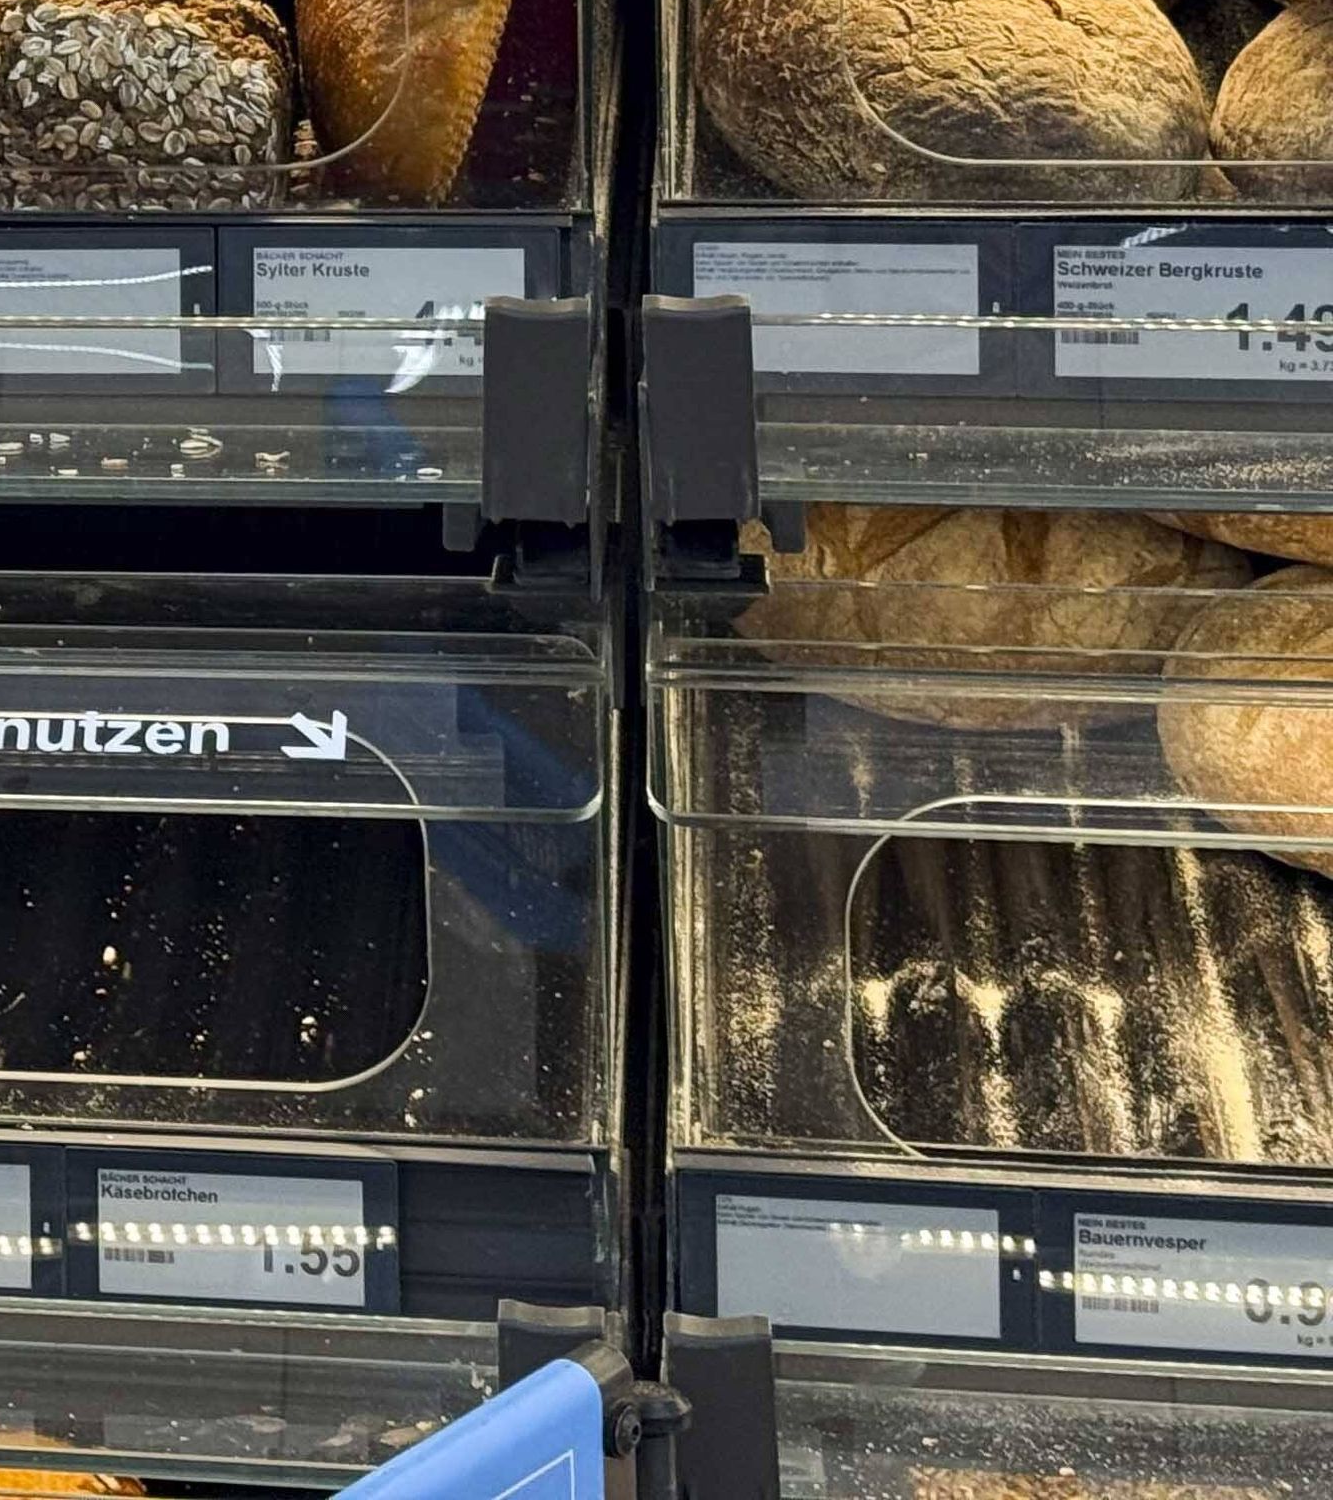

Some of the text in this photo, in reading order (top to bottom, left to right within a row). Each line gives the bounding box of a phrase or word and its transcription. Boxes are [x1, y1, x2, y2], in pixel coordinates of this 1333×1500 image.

[256, 263, 370, 278] Sylter Kruste
[1057, 261, 1263, 281] Schweizer Bergkruste
[1226, 303, 1333, 352] 1.49
[459, 354, 474, 367] kg
[1279, 359, 1296, 373] kg
[1078, 1229, 1207, 1252] Bauernvesper
